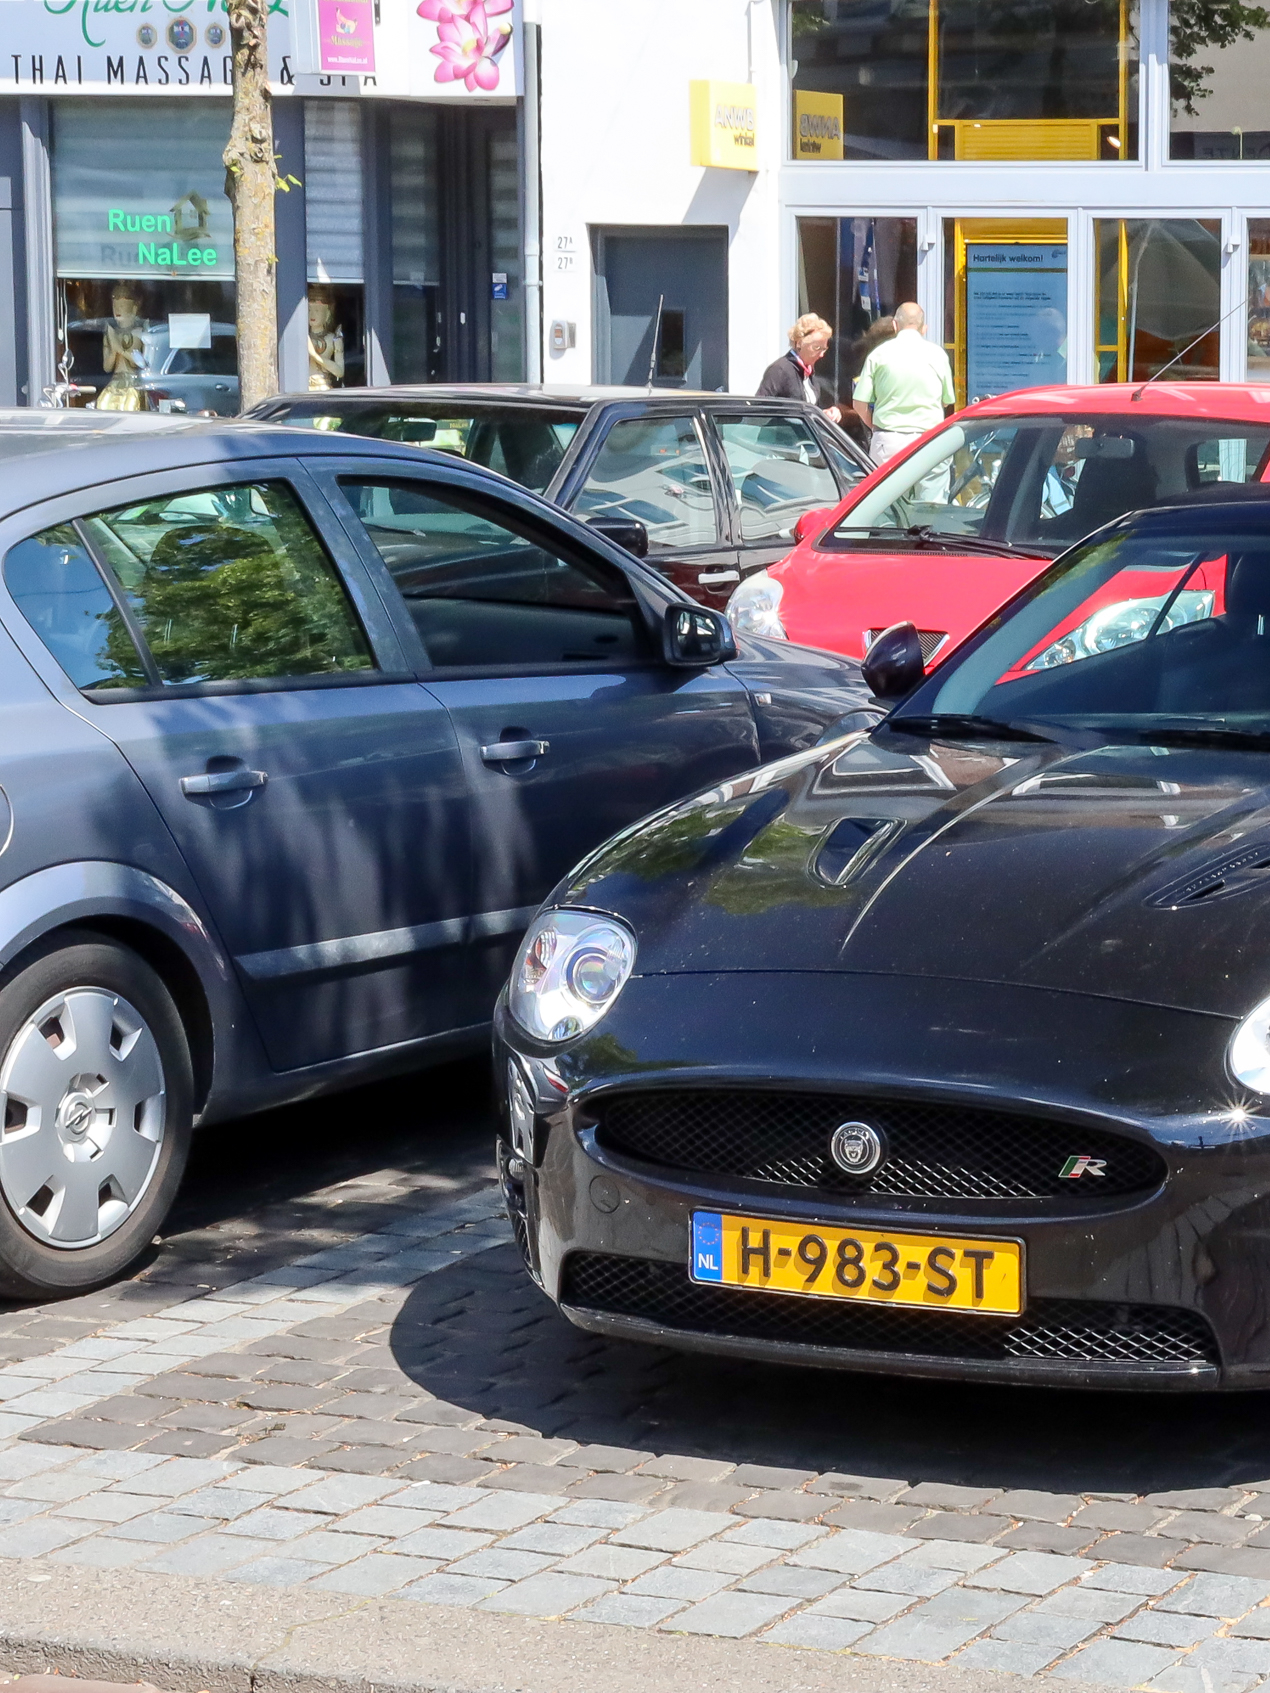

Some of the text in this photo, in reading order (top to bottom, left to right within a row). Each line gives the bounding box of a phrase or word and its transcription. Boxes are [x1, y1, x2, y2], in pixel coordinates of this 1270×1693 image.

[11, 55, 83, 85] THAI
[106, 55, 233, 87] MASSAG
[714, 104, 755, 131] ANWB
[108, 208, 171, 232] Ruen
[138, 242, 218, 266] NaLee
[1066, 1156, 1107, 1178] R
[697, 1252, 719, 1272] NL
[740, 1226, 994, 1300] H-983-ST
